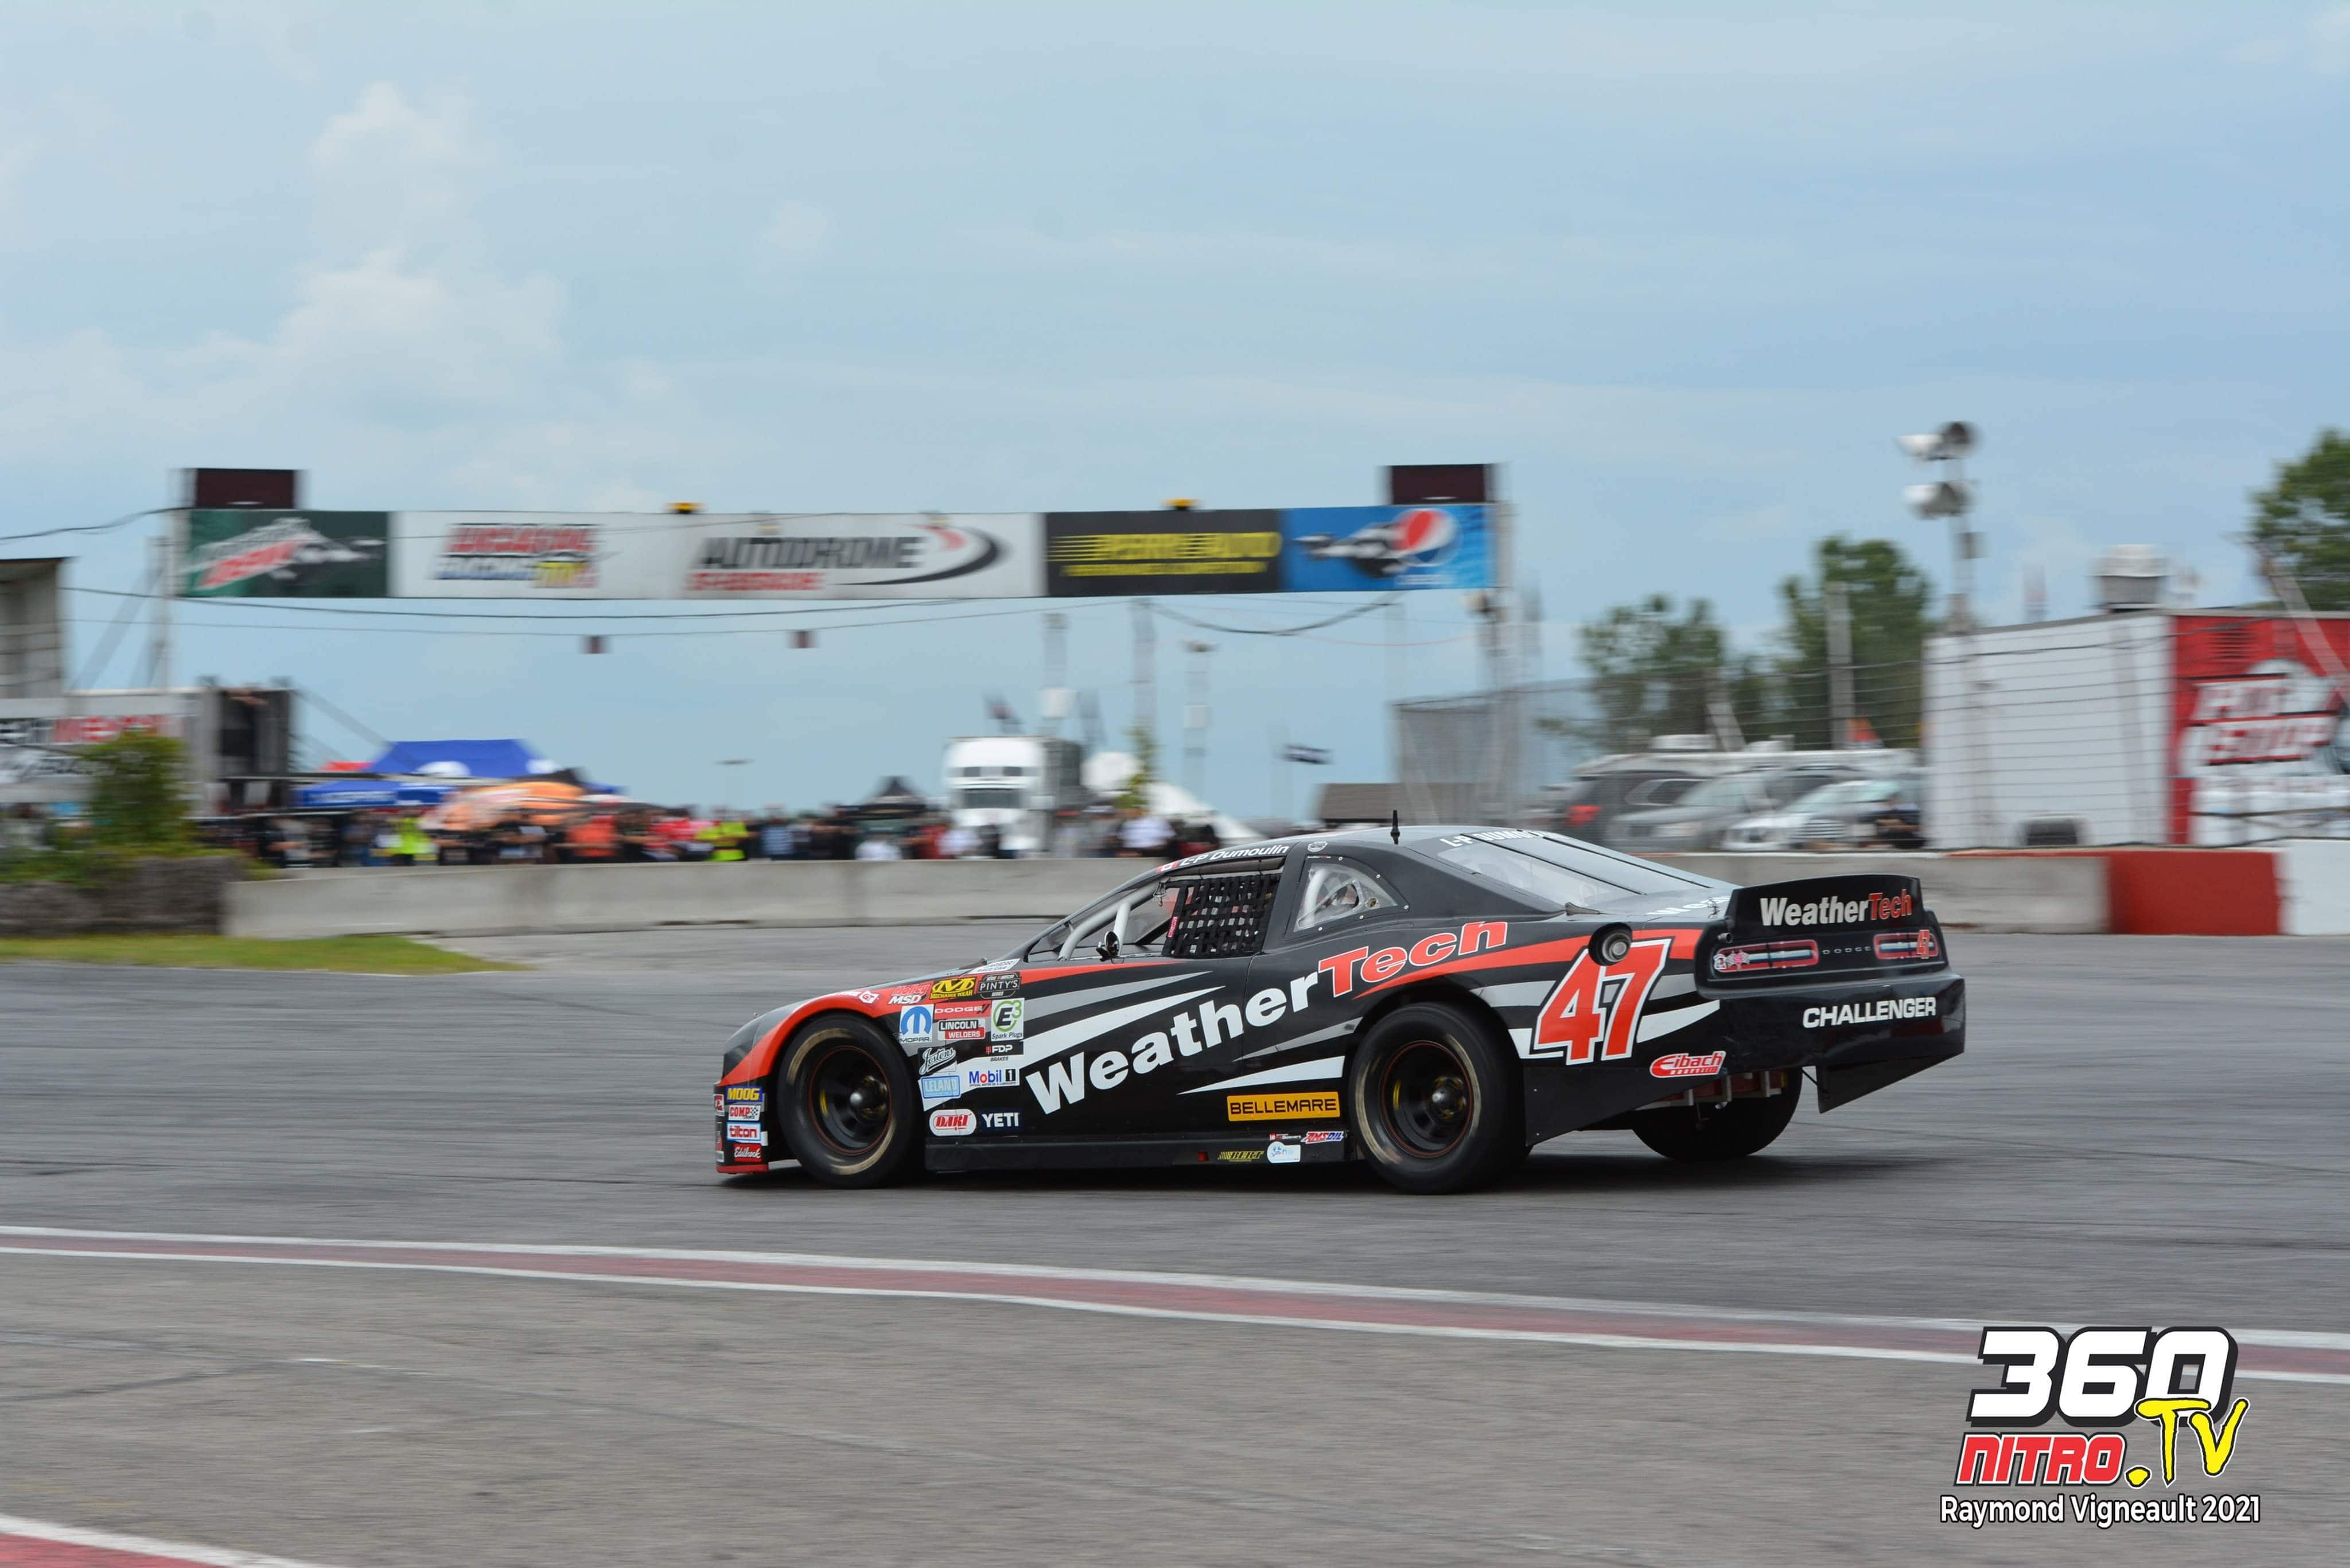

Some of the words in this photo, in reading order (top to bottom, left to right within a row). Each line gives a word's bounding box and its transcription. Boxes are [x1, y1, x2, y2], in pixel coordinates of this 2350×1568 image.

[1180, 854, 1208, 866] L-P
[1209, 845, 1289, 860] Dumoulin
[1760, 889, 1912, 927] WeatherTech
[980, 980, 1018, 991] PINTY'S
[888, 994, 921, 1004] MSD
[1533, 939, 1672, 1065] 47
[1803, 997, 1936, 1028] CHALLENGER
[941, 1021, 977, 1030] LINCOLN
[1009, 1031, 1024, 1039] Plugs
[992, 1044, 1013, 1053] FDP
[1651, 1052, 1723, 1076] Eibach
[969, 1069, 1002, 1084] Mobil
[1007, 1069, 1014, 1081] 1
[727, 1088, 761, 1100] MOOG
[729, 1107, 750, 1117] COMP
[1230, 1099, 1336, 1115] BELLEMARE
[982, 1112, 1020, 1128] YETI
